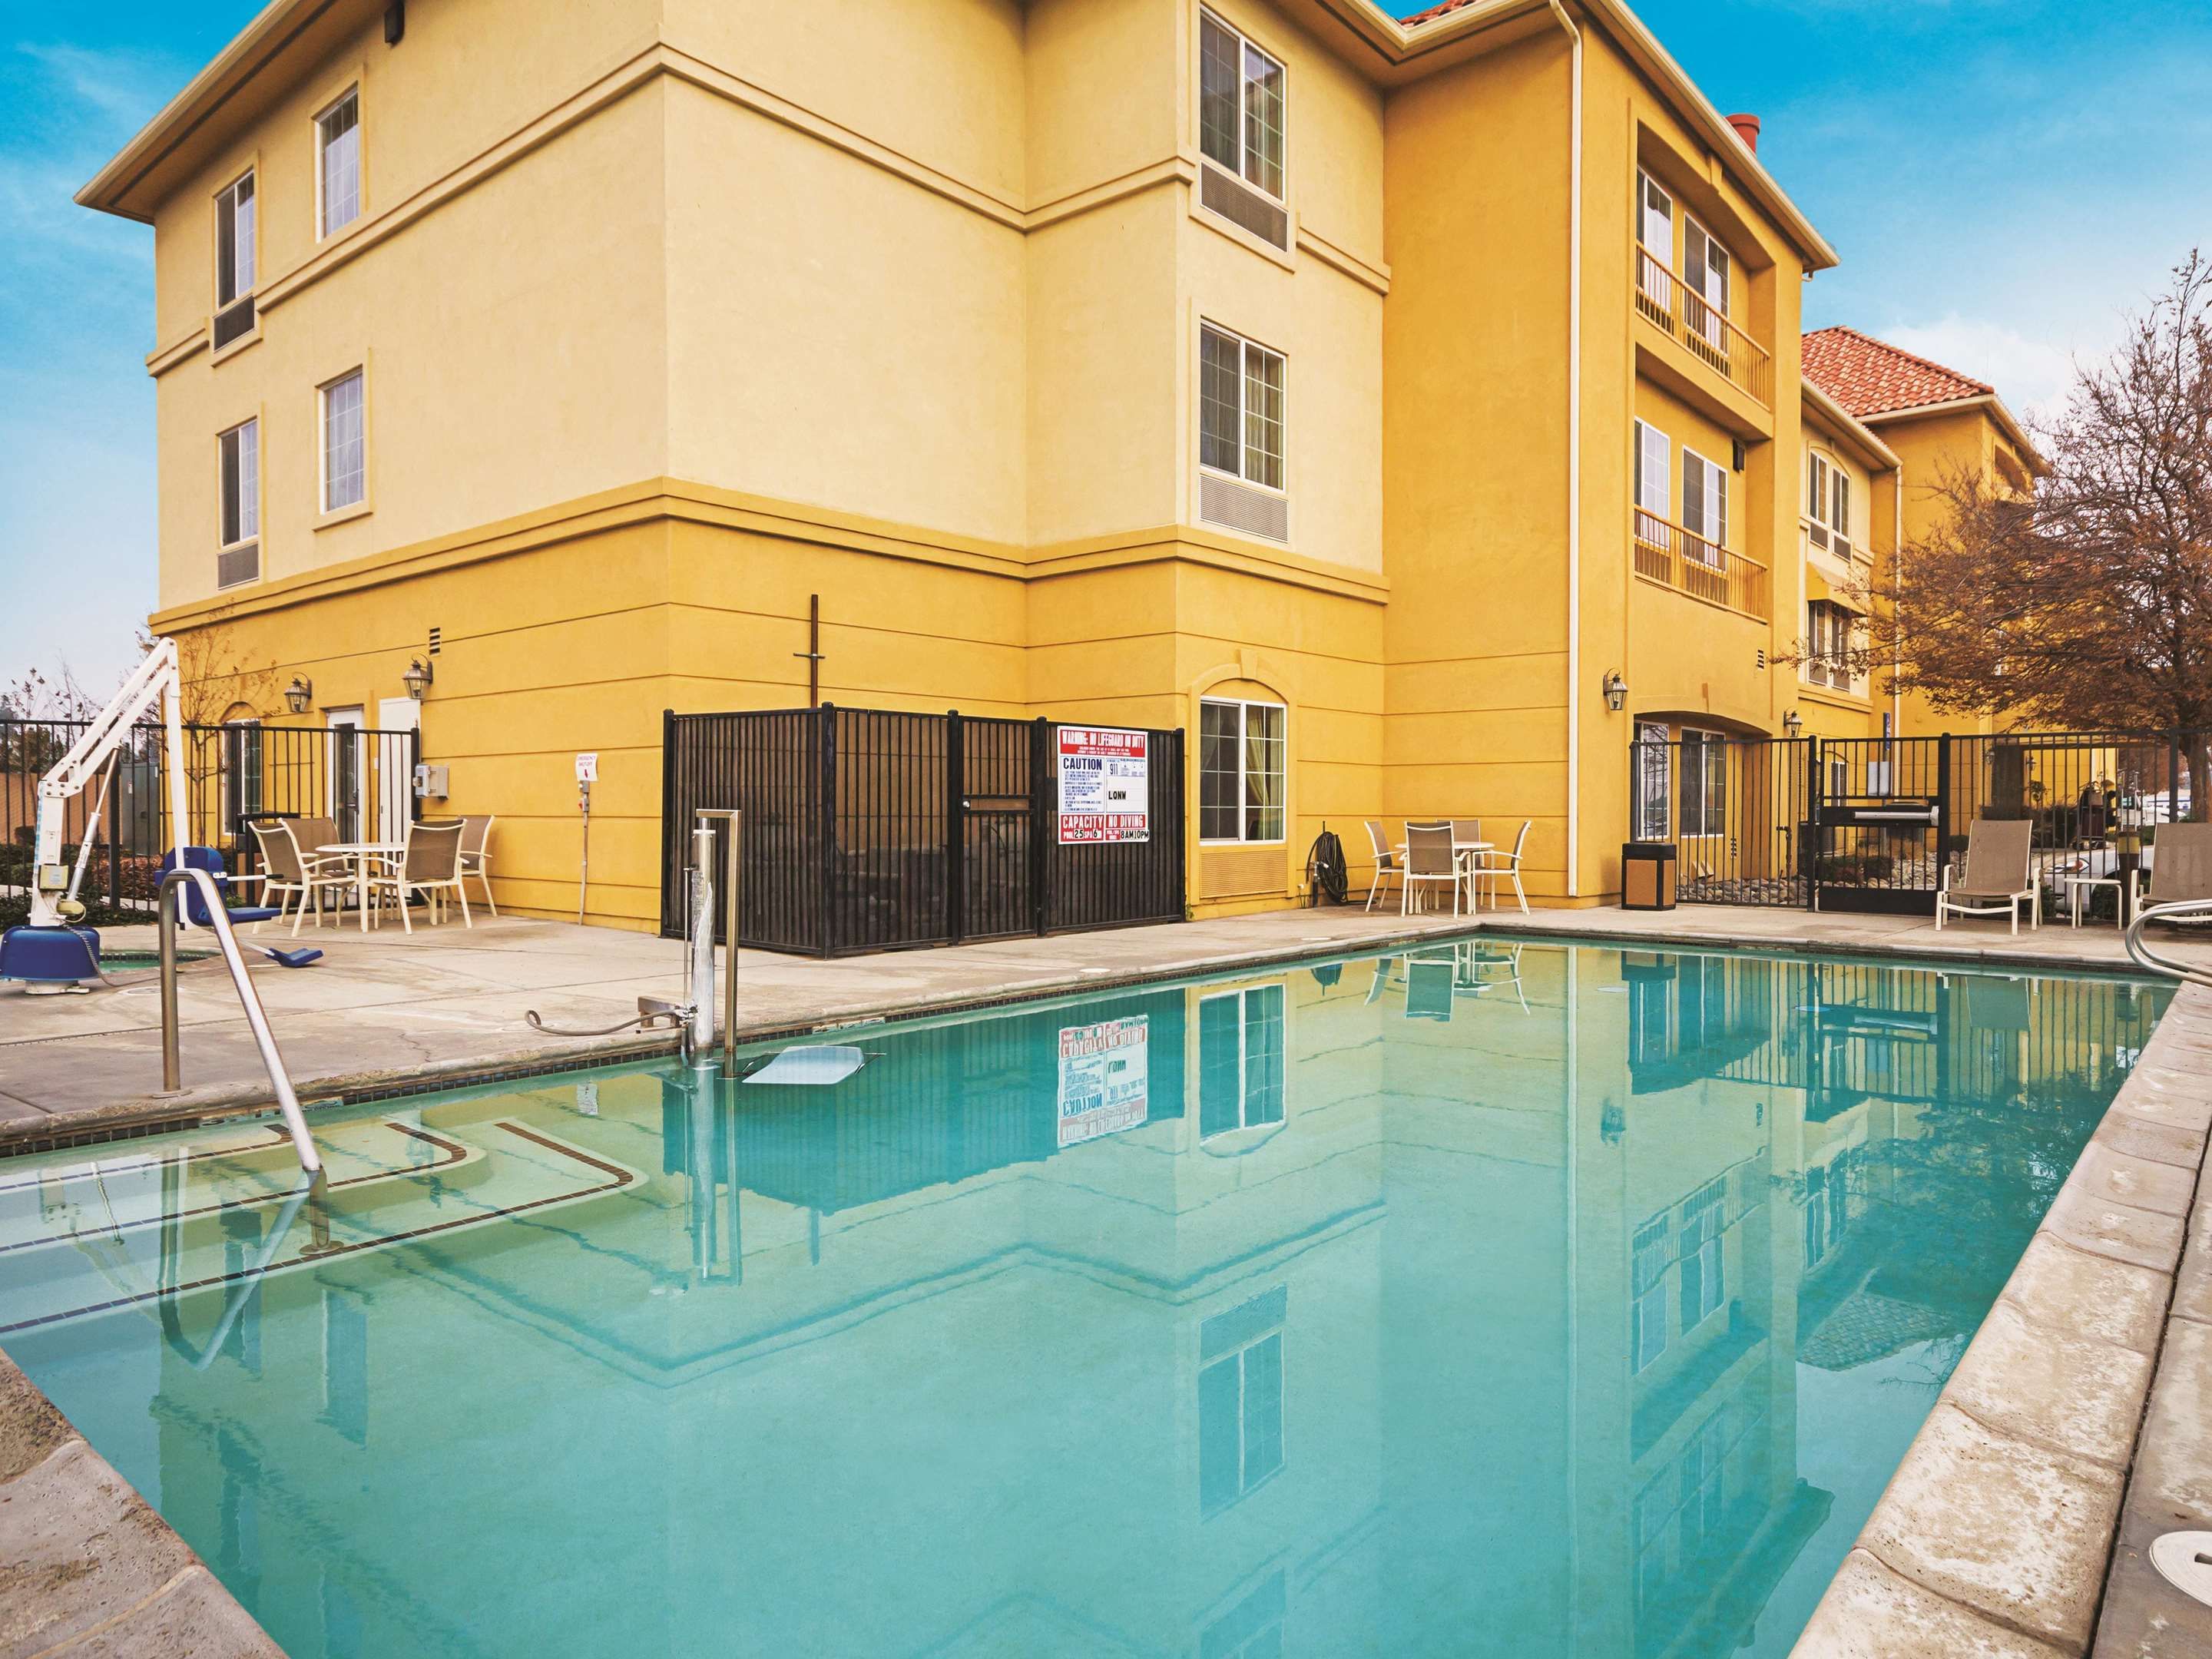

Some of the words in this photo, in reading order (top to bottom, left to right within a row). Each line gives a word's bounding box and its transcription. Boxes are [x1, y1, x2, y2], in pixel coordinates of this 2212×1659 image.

[1132, 735, 1144, 748] DUTY
[1063, 757, 1102, 770] CAUTION
[1110, 763, 1118, 775] 911
[1063, 816, 1104, 829] CAPACITY
[1108, 815, 1118, 828] NO
[1121, 815, 1144, 827] DIVING
[1075, 830, 1084, 838] 25
